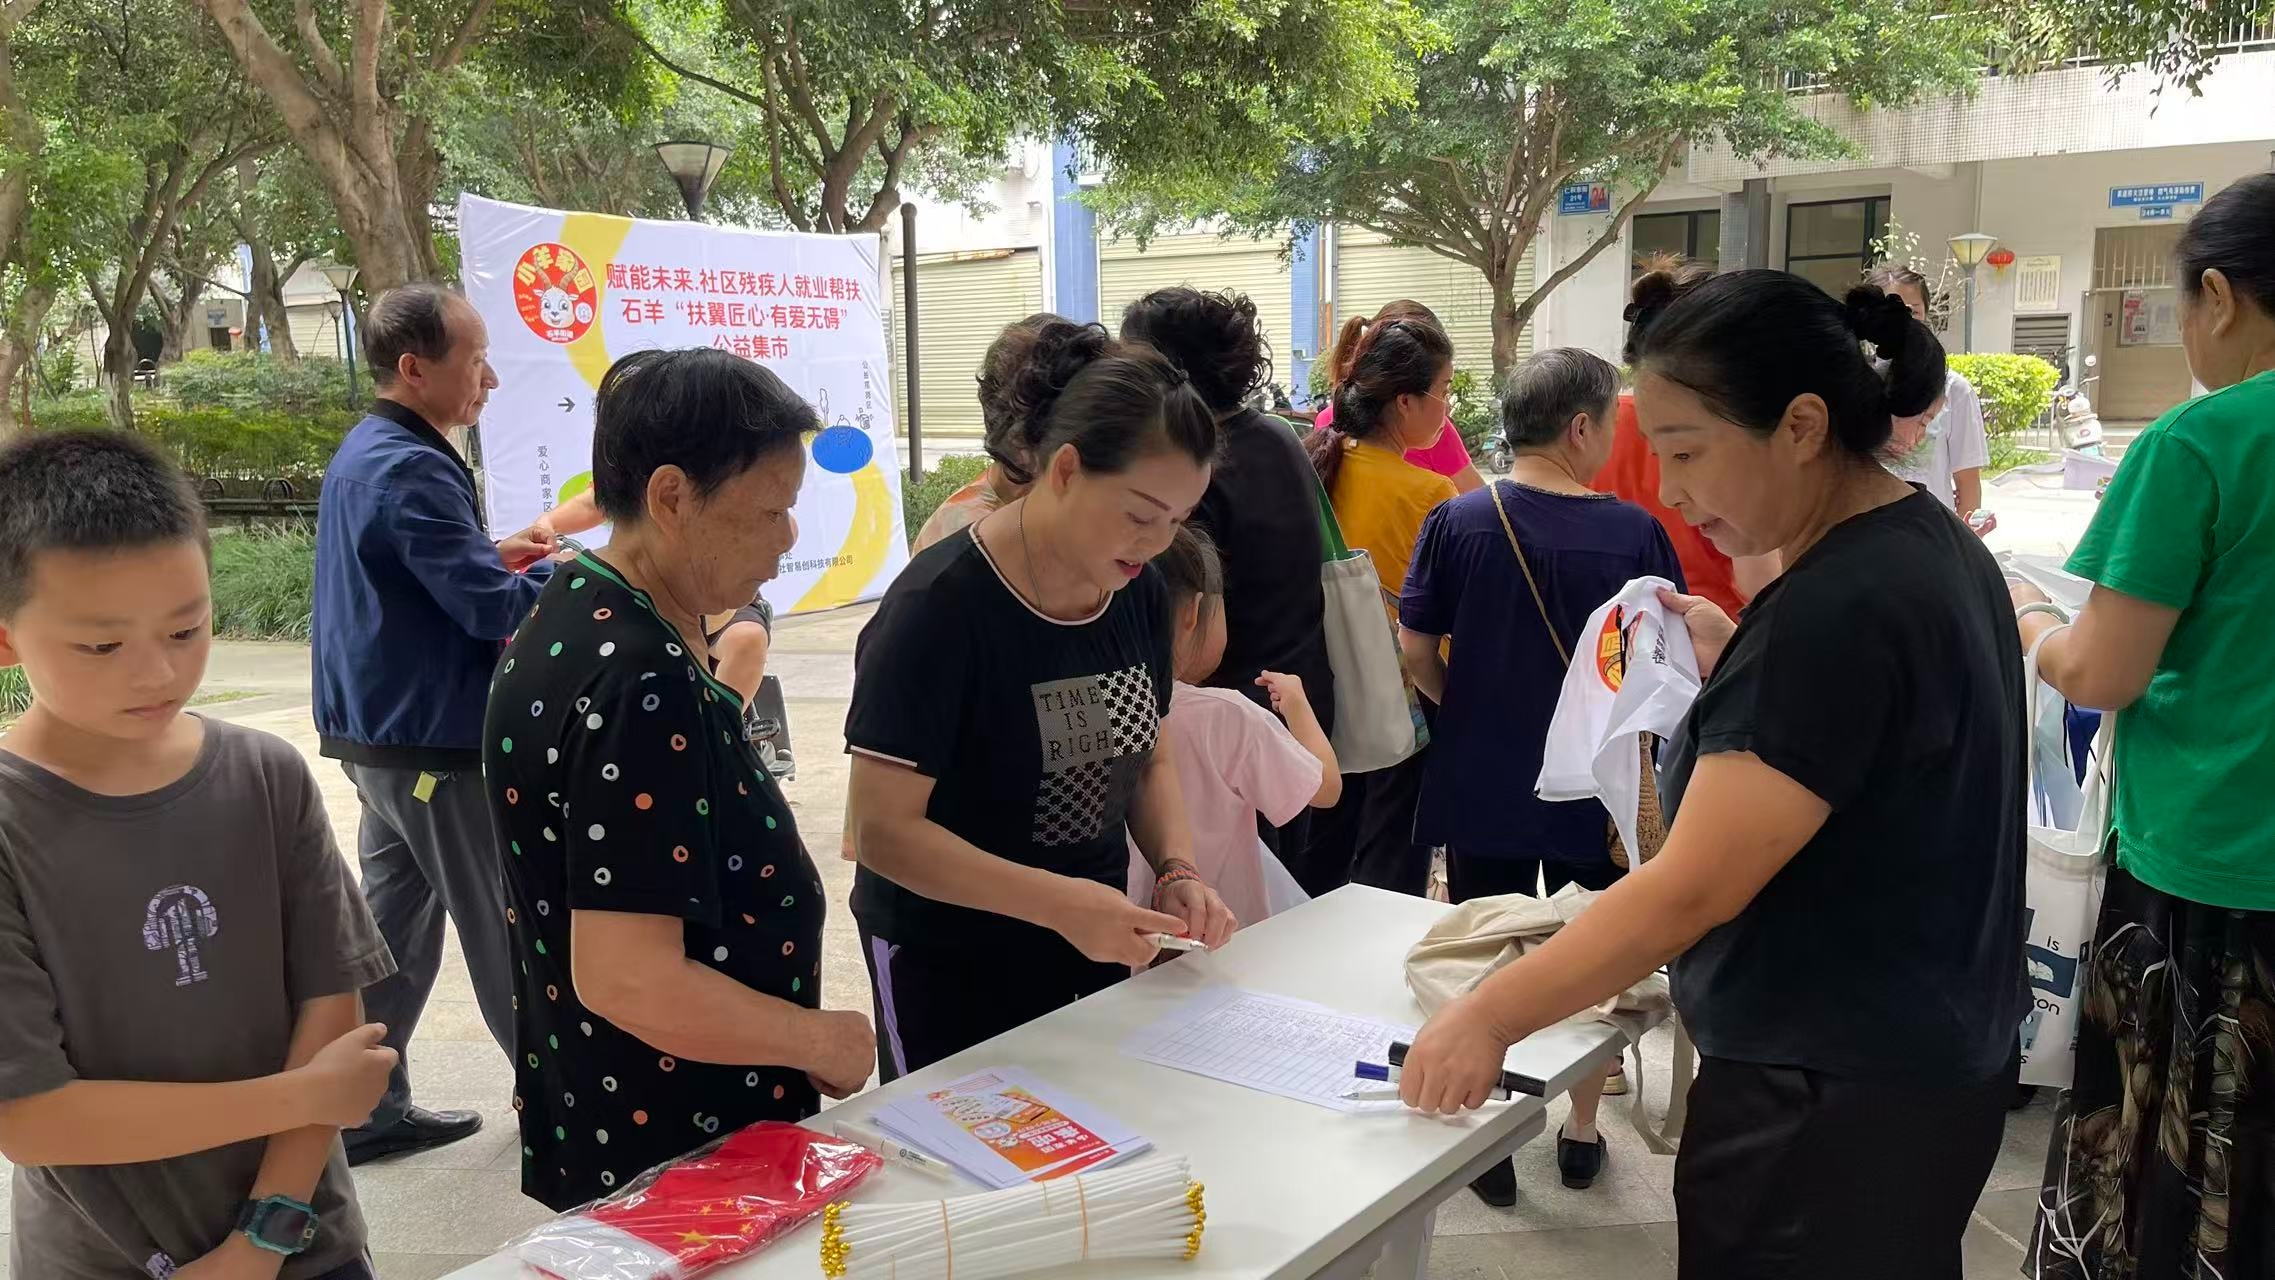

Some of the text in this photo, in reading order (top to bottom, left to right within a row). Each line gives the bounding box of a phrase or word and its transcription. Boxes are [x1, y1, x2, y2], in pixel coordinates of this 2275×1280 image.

[713, 334, 790, 360] 公益集市
[537, 446, 553, 513] 爱心商家区
[1039, 686, 1101, 712] TIME
[1064, 710, 1089, 731] IS
